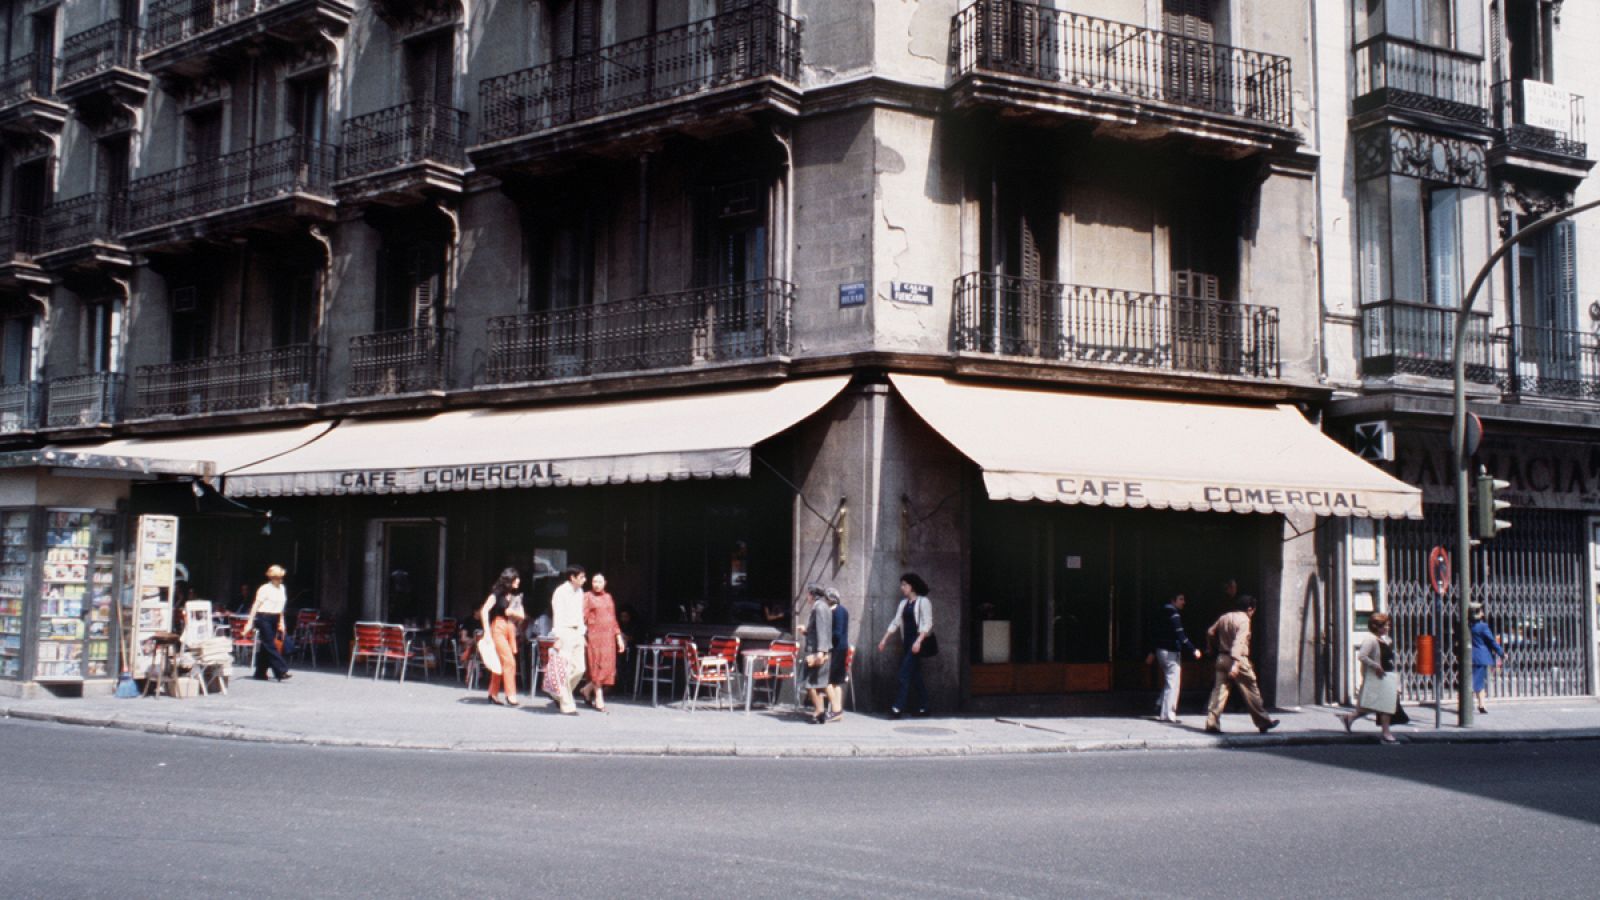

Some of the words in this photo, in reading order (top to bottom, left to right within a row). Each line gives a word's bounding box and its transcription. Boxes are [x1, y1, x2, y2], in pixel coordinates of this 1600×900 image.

[340, 471, 397, 487] CAFE
[423, 463, 562, 485] COMERCIAL
[1056, 478, 1144, 498] CAFE
[1203, 486, 1368, 509] COMERCIAL
